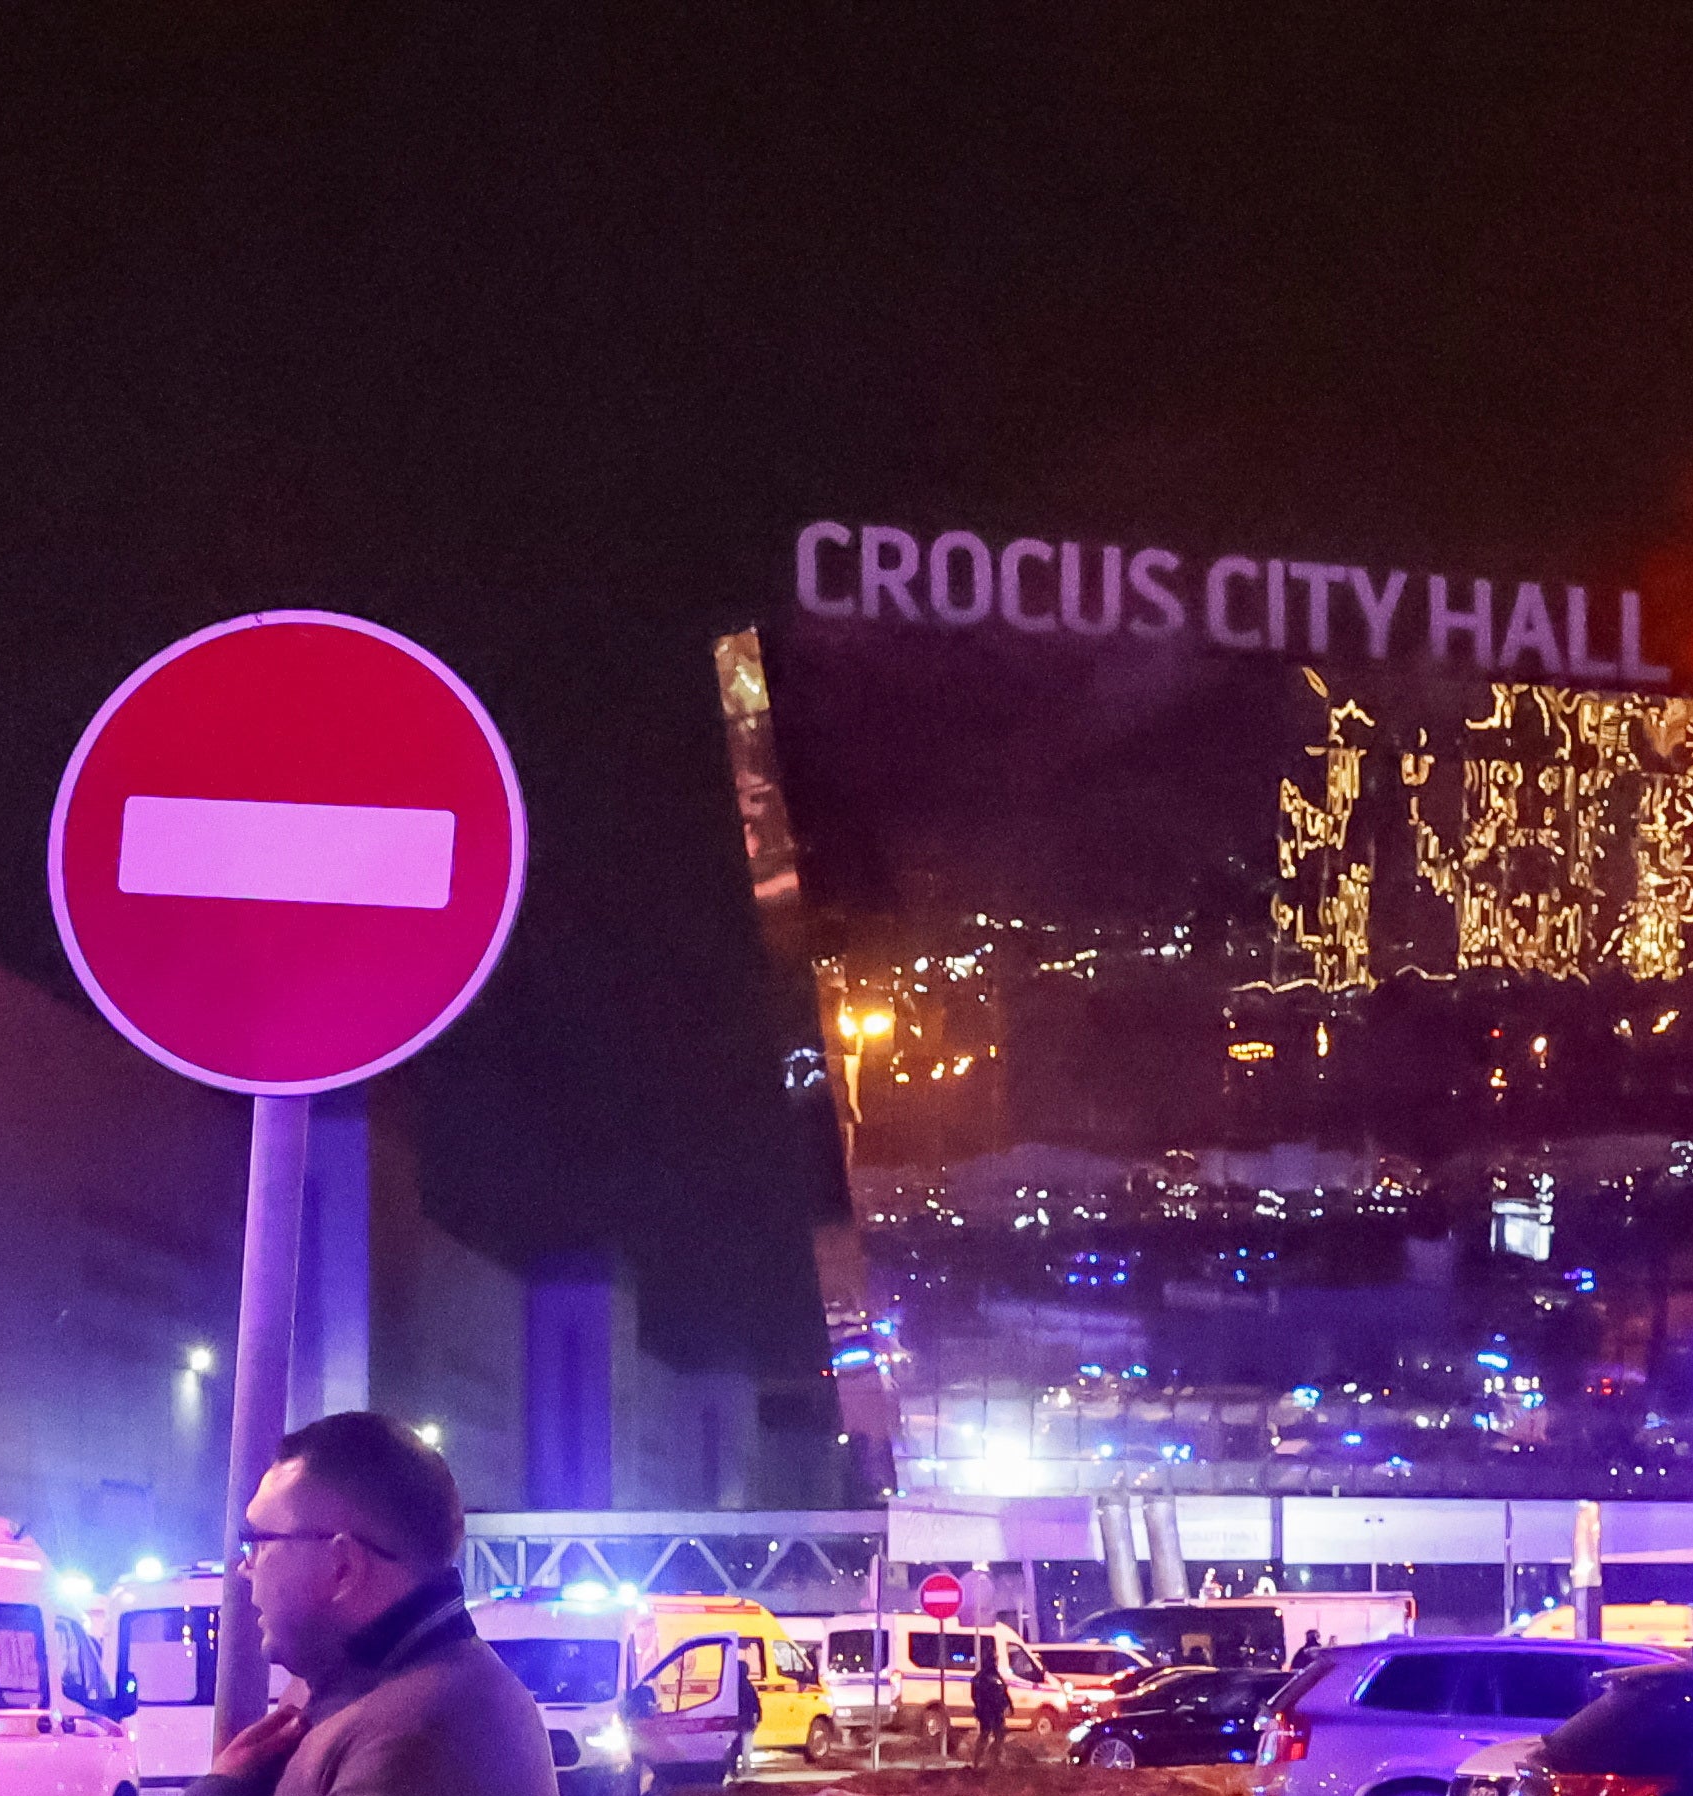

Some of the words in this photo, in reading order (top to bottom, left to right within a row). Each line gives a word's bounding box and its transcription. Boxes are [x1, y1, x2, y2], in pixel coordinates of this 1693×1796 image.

[796, 520, 1186, 637] CROCUS
[1206, 554, 1408, 660] CITY
[1427, 573, 1672, 682] HALL
